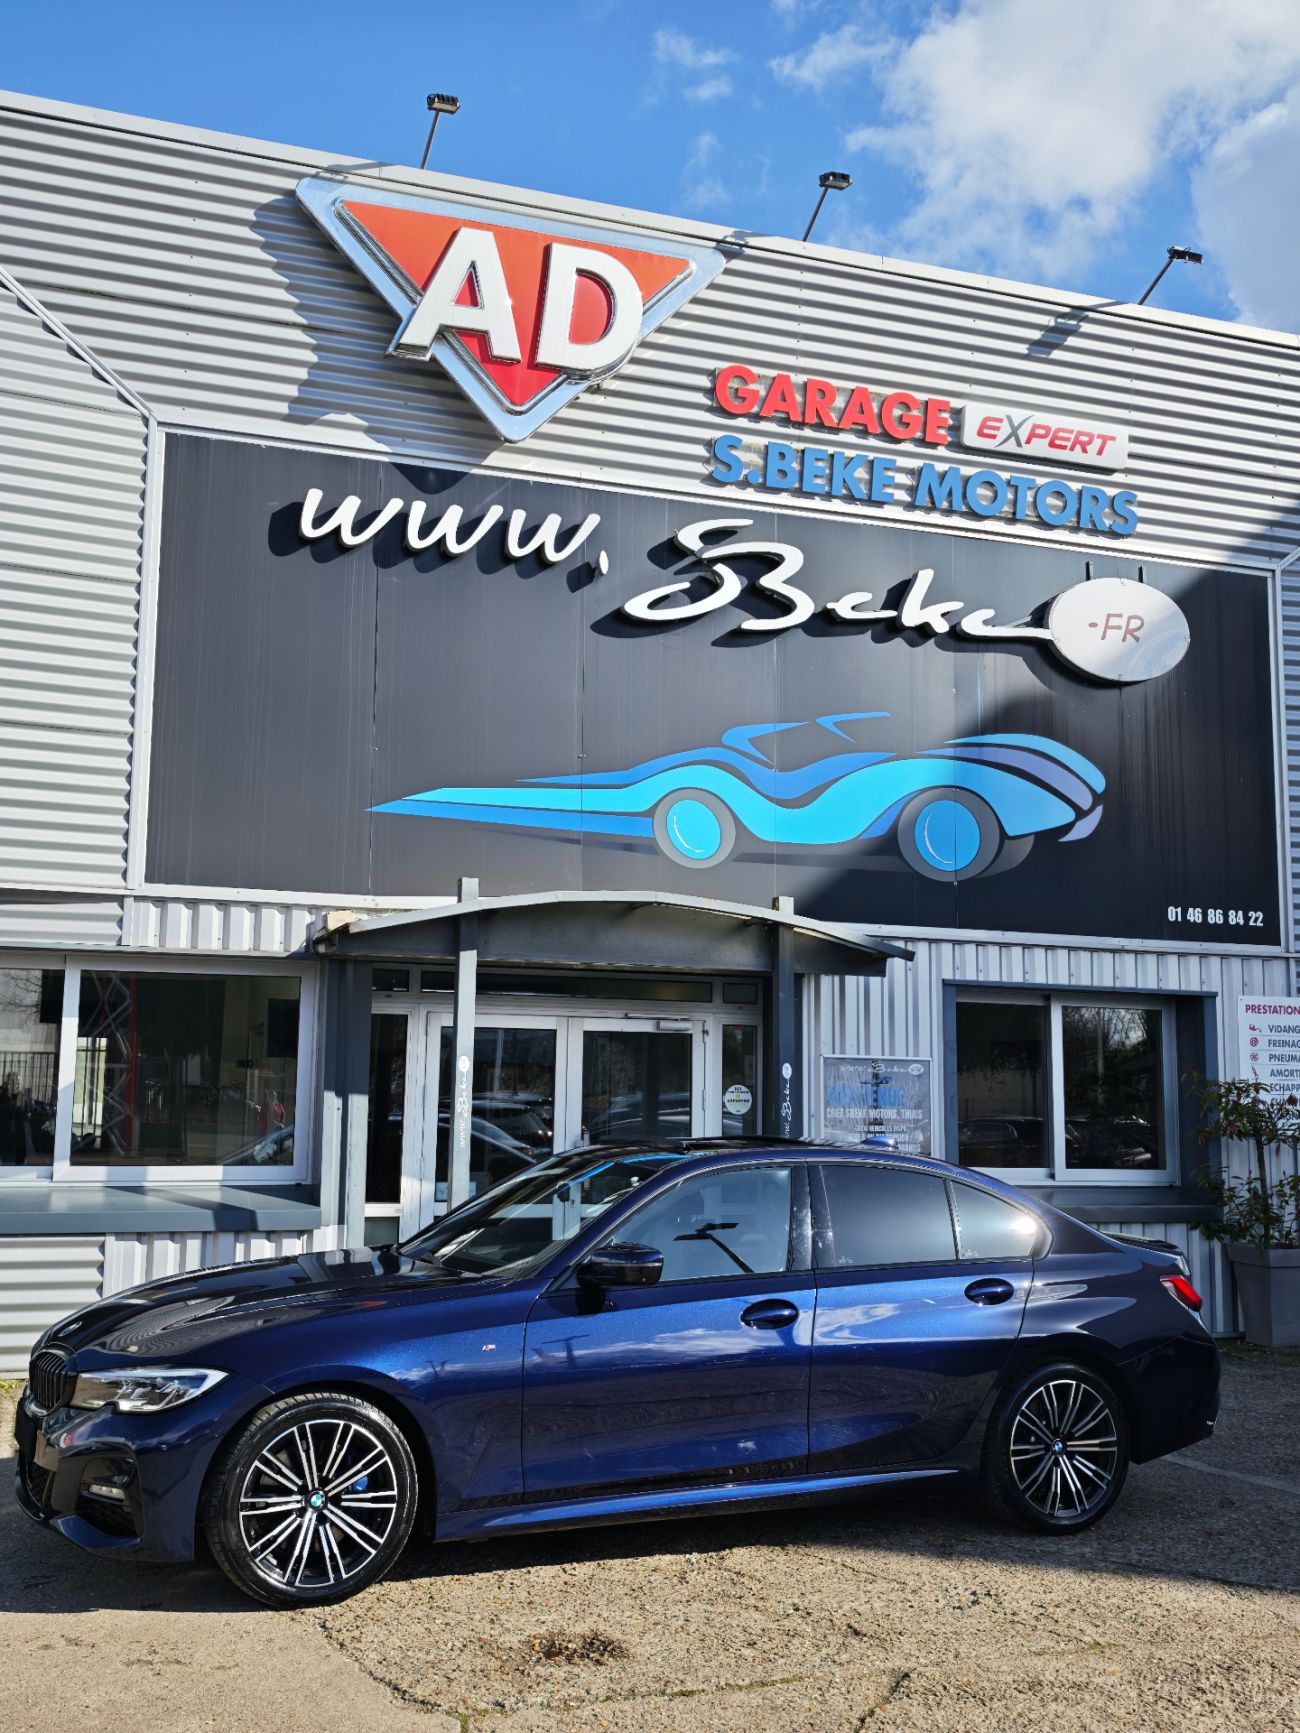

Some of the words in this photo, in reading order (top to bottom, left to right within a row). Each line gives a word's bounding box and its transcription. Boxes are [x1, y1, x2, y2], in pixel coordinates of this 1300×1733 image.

[393, 226, 644, 371] AD
[714, 365, 951, 445] GARAGE
[711, 434, 897, 504] S.BEKE
[913, 462, 1139, 536] MOTORS
[1167, 905, 1183, 922] 01
[1186, 907, 1203, 924] 46
[1207, 908, 1224, 924] 86
[1228, 909, 1245, 925] 84
[1248, 911, 1264, 927] 22
